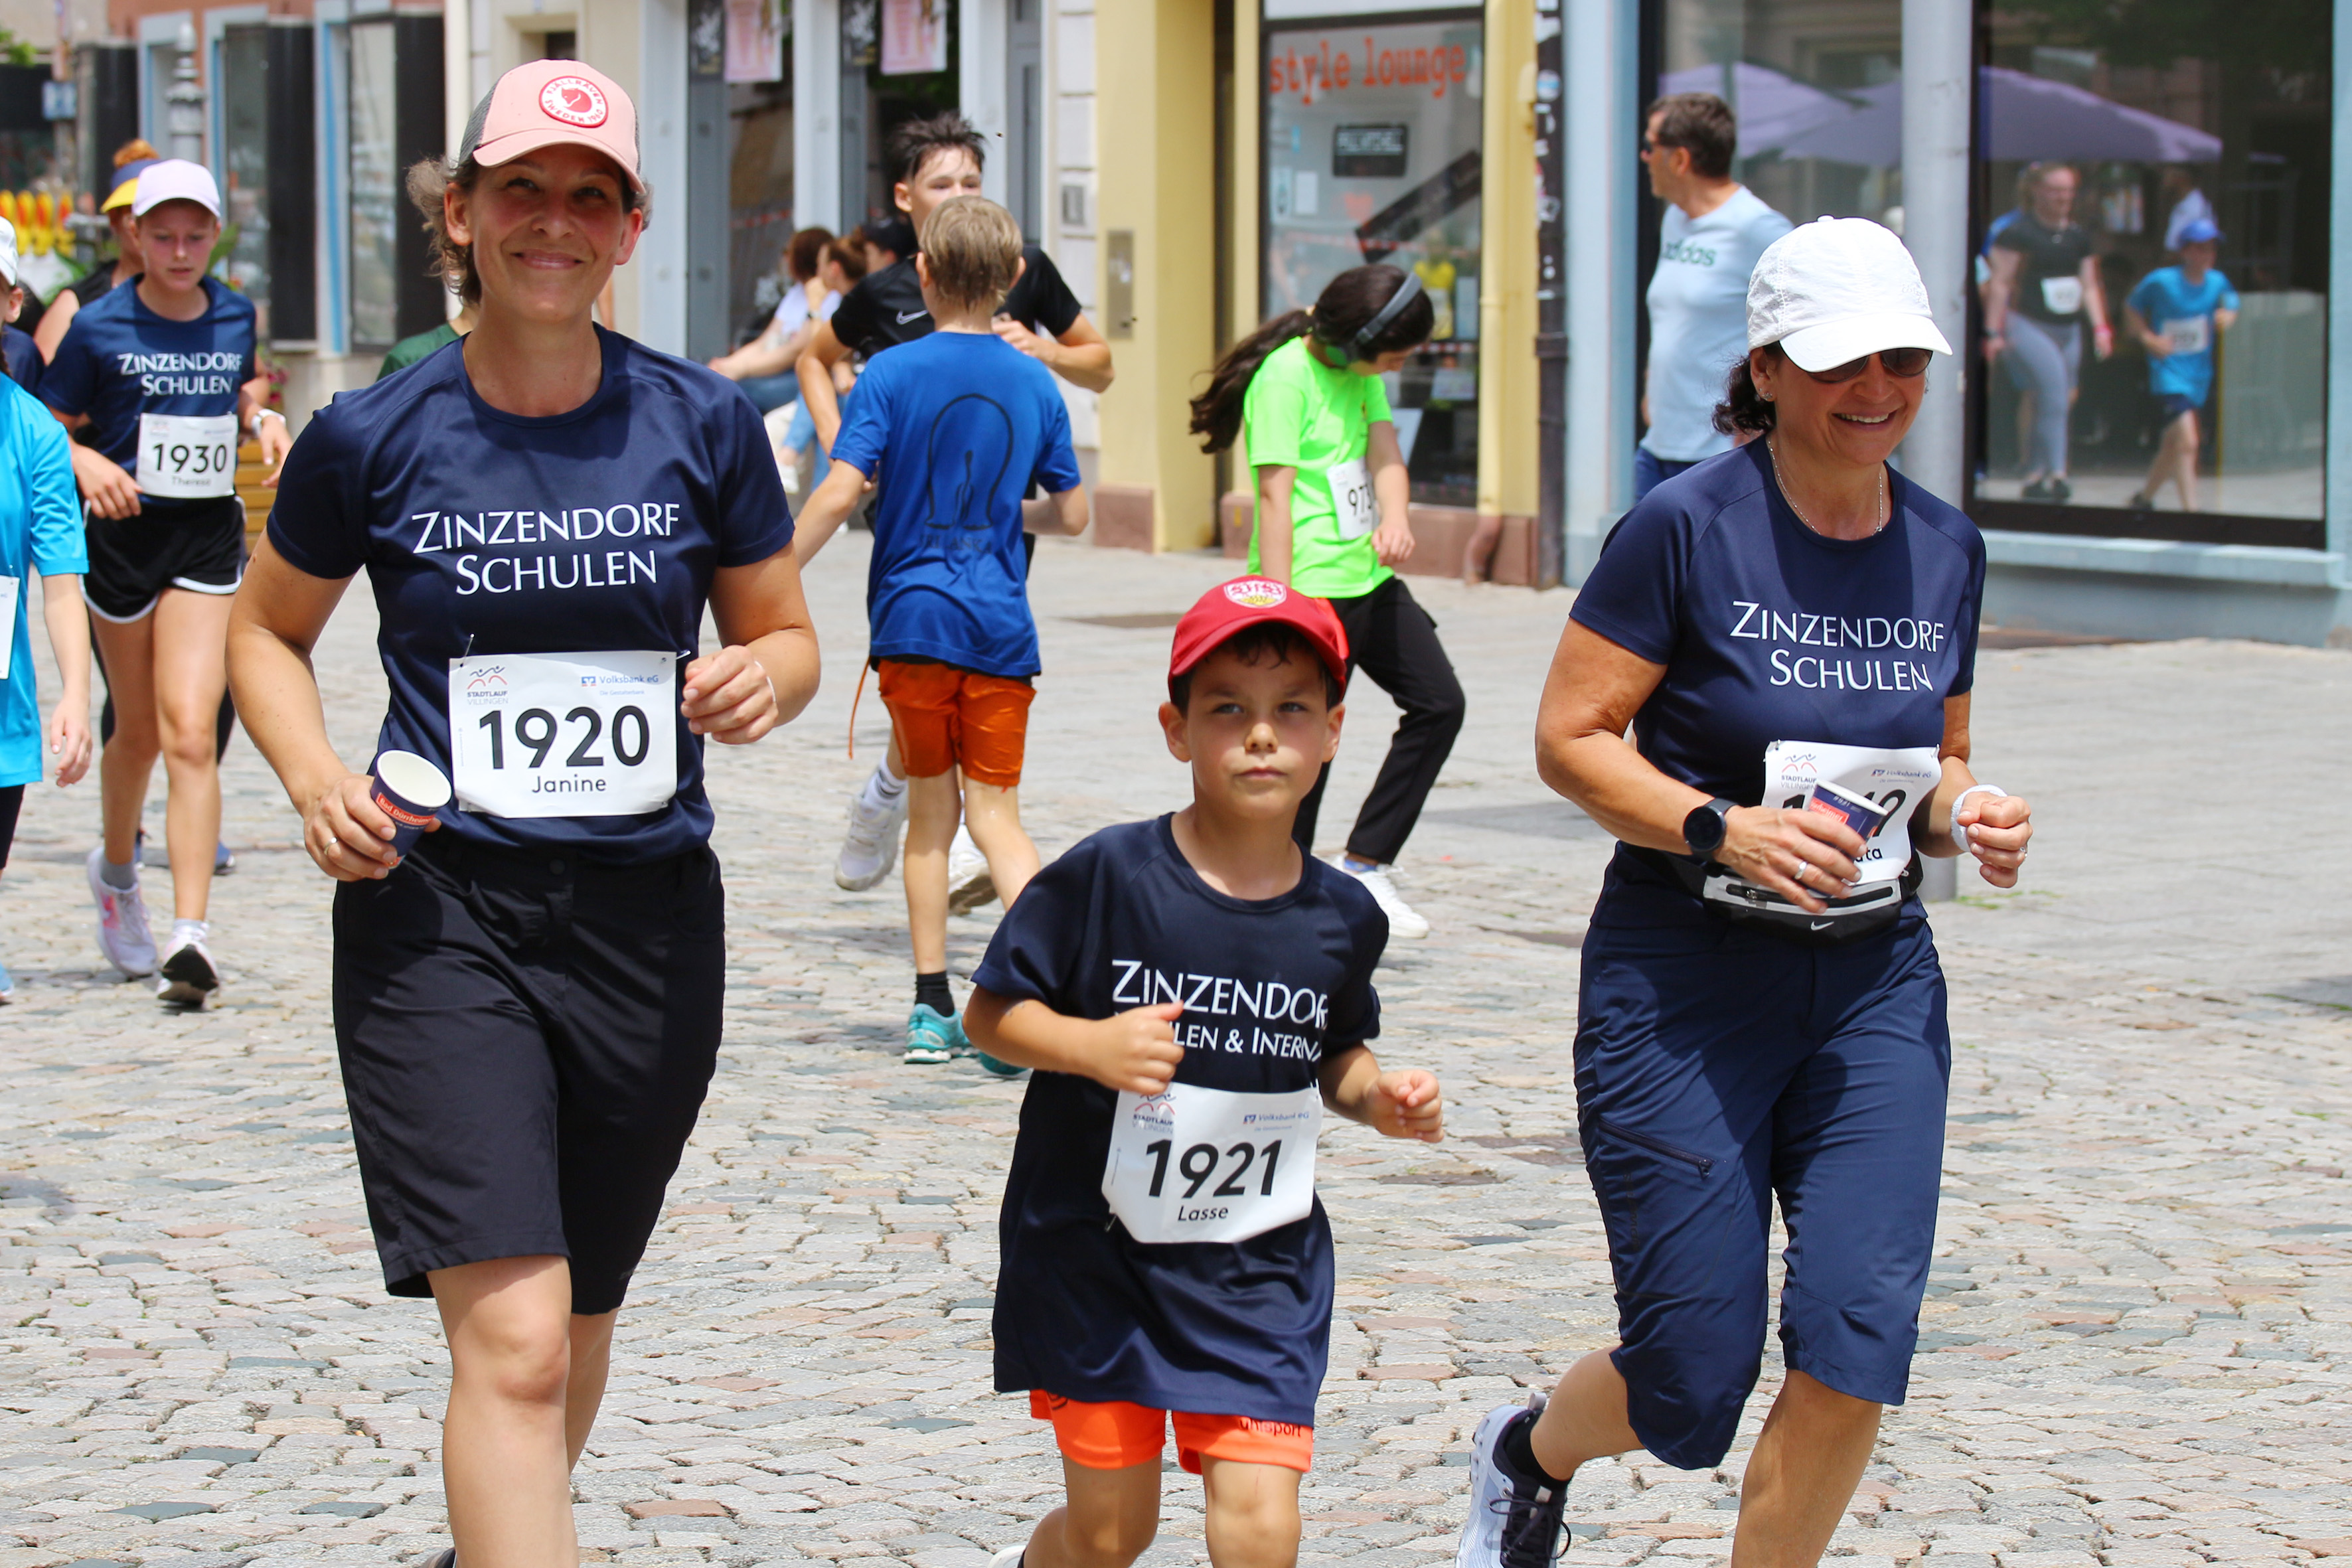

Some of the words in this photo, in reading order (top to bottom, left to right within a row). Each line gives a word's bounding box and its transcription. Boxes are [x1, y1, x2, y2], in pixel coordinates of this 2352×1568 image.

[1269, 40, 1350, 105] style
[1363, 37, 1466, 98] lounge
[118, 352, 242, 376] ZINZENDORF
[141, 374, 233, 396] SCHULEN
[153, 443, 227, 473] 1930
[412, 503, 680, 554] ZINZENDORF
[456, 550, 657, 595] SCHULEN
[1730, 601, 1944, 653] ZINZENDORF
[599, 674, 645, 684] Volksbank
[647, 674, 659, 683] eG
[1770, 649, 1934, 692] SCHULEN
[467, 697, 509, 706] VILLINGEN
[479, 705, 650, 770] 1920
[532, 774, 607, 793] Janine
[1112, 959, 1328, 1030] ZINZENDOR
[1225, 1028, 1243, 1054] &
[1146, 1138, 1282, 1199] 1921
[1178, 1206, 1228, 1221] Lasse
